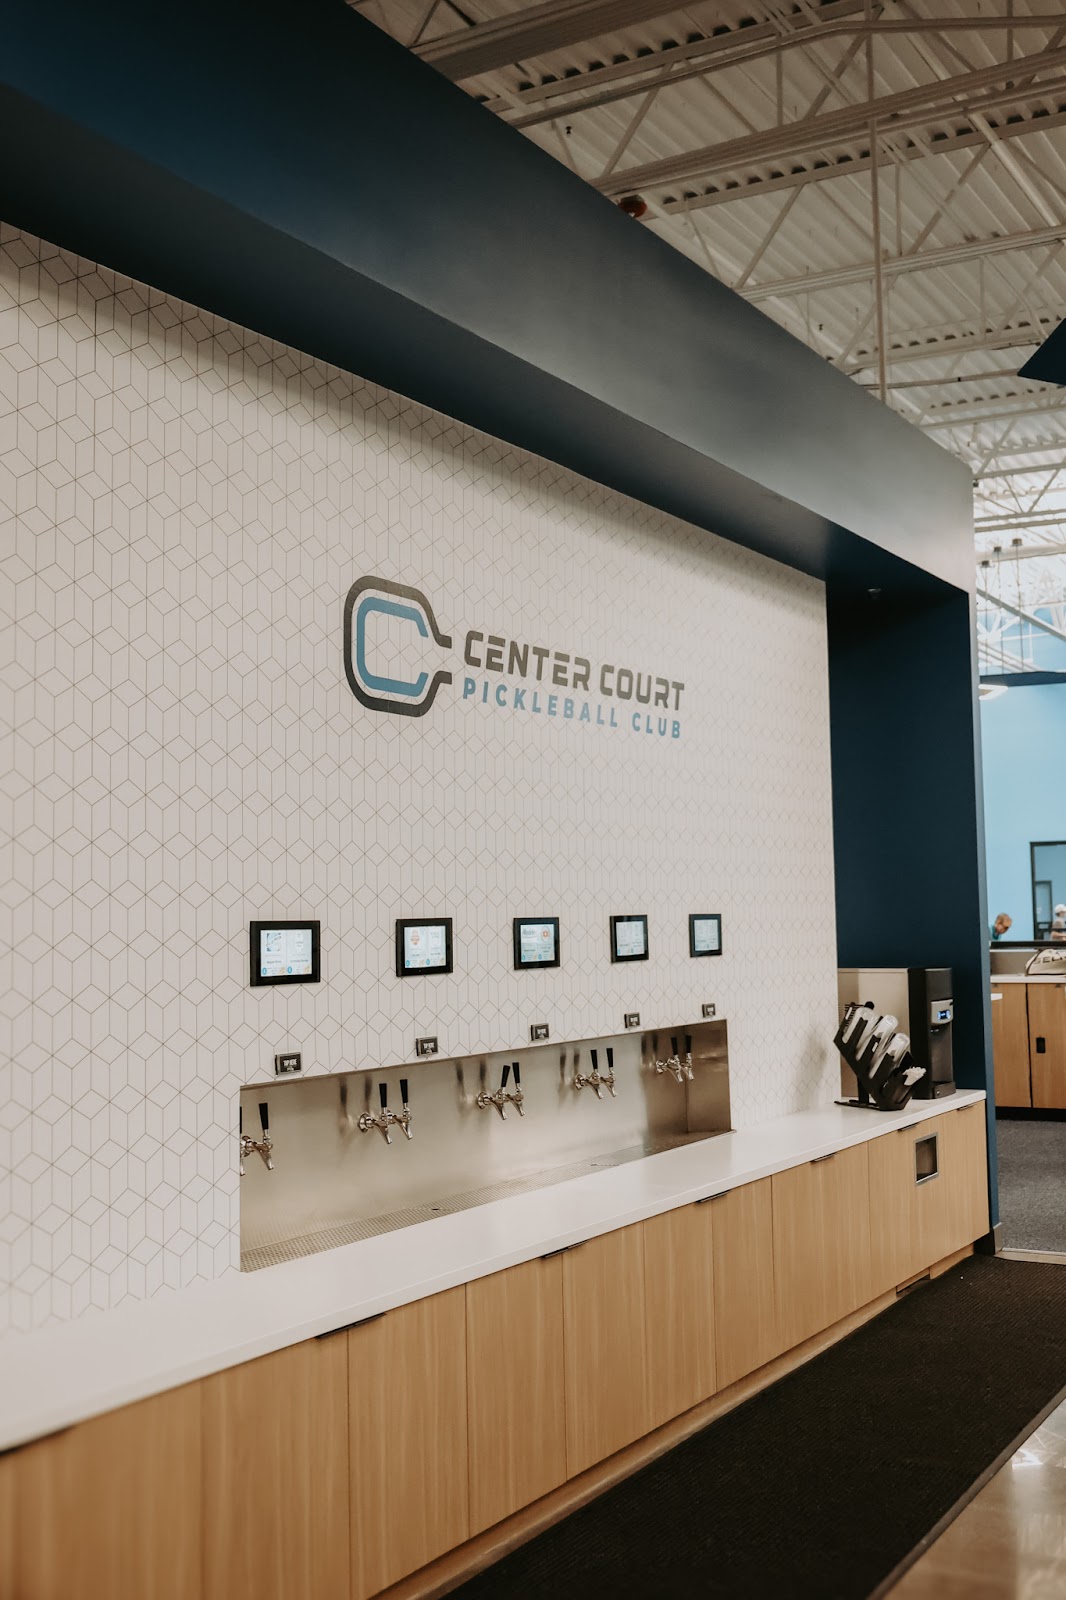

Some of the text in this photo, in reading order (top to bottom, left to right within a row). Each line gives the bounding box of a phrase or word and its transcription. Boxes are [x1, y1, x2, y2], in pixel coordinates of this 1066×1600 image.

[464, 630, 685, 711] CENTER COURT
[463, 677, 681, 739] PICKLEBALL CLUB
